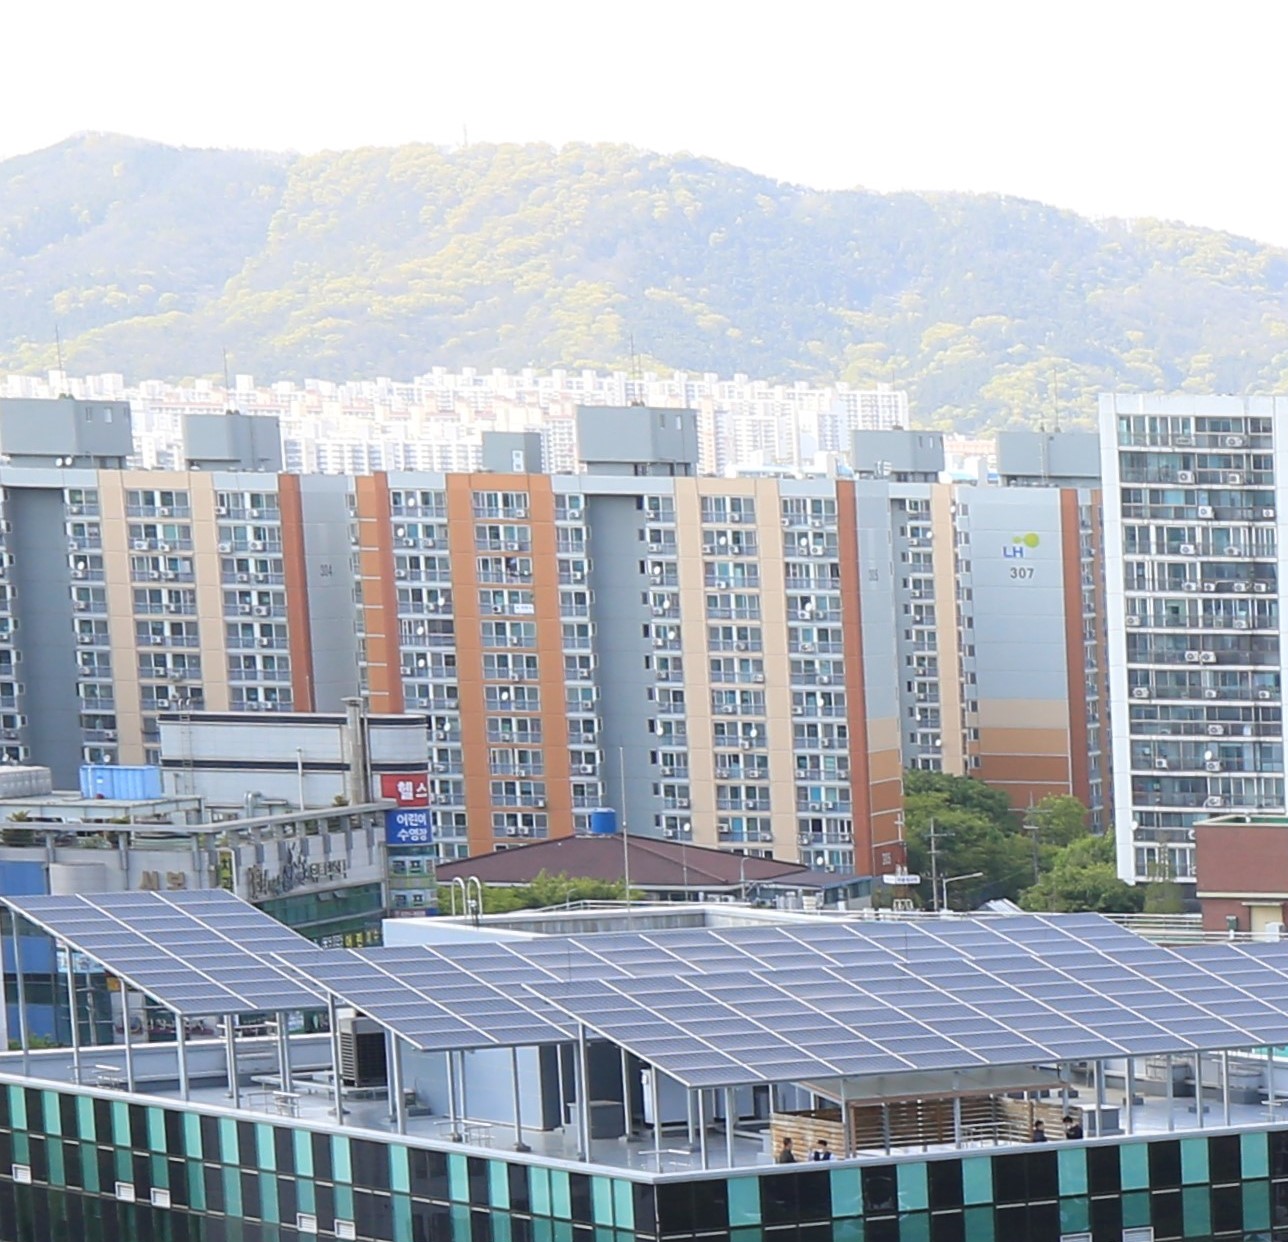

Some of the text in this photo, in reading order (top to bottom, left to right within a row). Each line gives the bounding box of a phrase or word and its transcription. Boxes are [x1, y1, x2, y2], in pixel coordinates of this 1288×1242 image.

[1003, 546, 1024, 558] LH
[1010, 567, 1034, 579] 307
[397, 780, 429, 801] 헬스
[396, 812, 428, 827] 어린이
